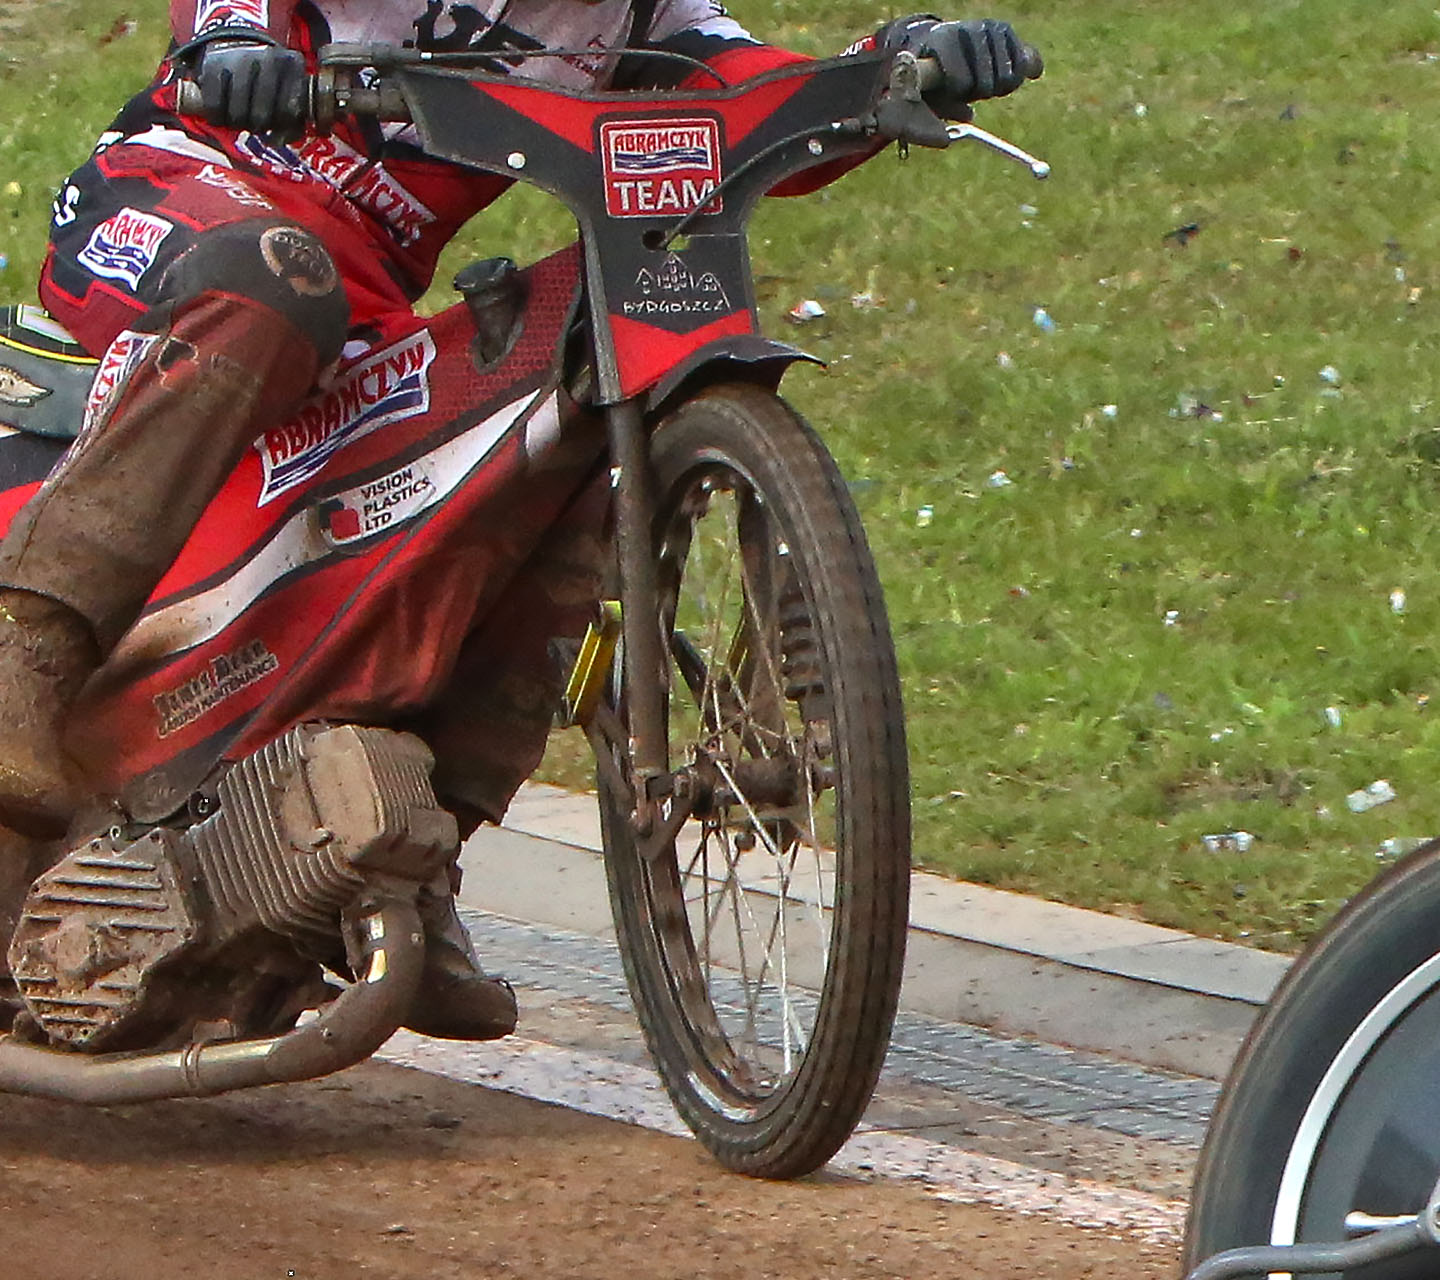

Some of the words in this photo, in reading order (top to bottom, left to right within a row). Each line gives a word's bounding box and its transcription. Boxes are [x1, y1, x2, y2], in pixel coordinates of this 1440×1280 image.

[613, 130, 709, 153] ABRAMCZYK
[613, 179, 715, 211] TEAM
[623, 299, 724, 313] BYDGOSZCZ
[360, 468, 413, 499] VISION
[363, 476, 430, 516] PLASTICS
[364, 512, 392, 532] LTD
